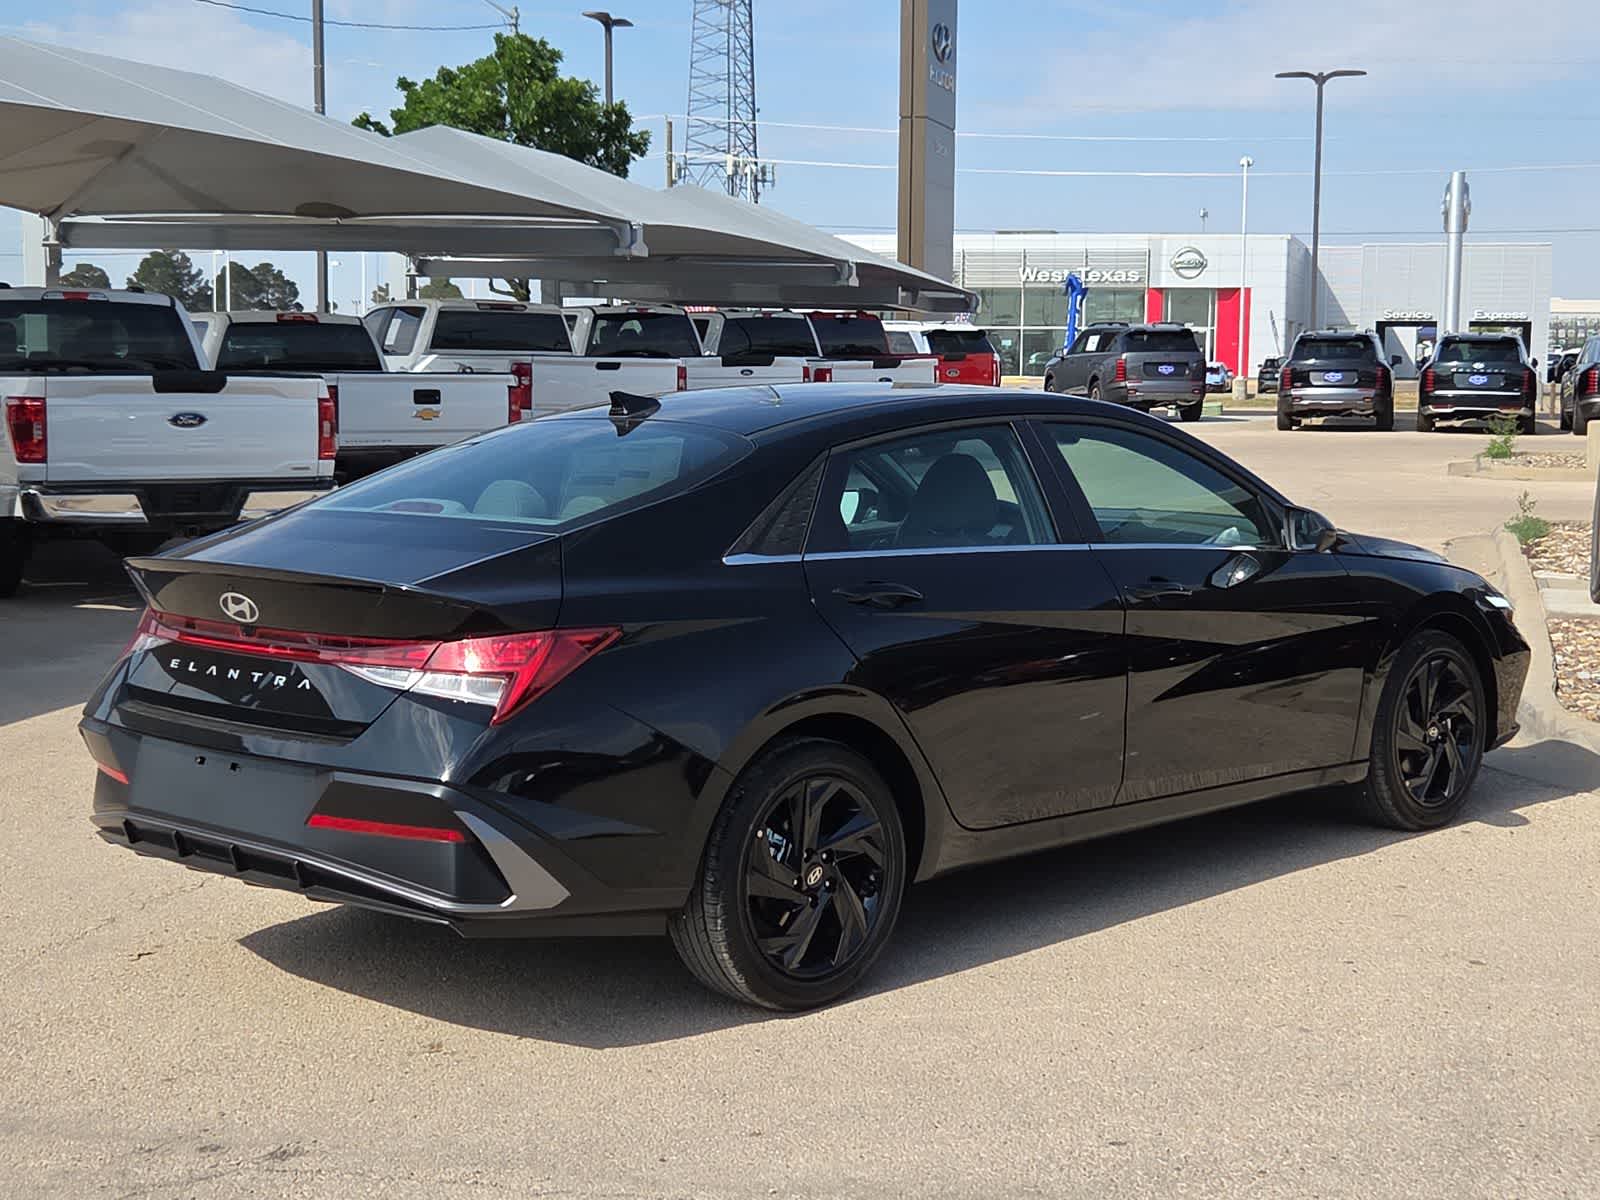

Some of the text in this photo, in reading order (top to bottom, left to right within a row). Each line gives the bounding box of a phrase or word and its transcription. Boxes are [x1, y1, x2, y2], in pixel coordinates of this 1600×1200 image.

[1019, 267, 1139, 281] West Texas
[1473, 310, 1527, 321] Express
[170, 658, 311, 690] ELANTRA
